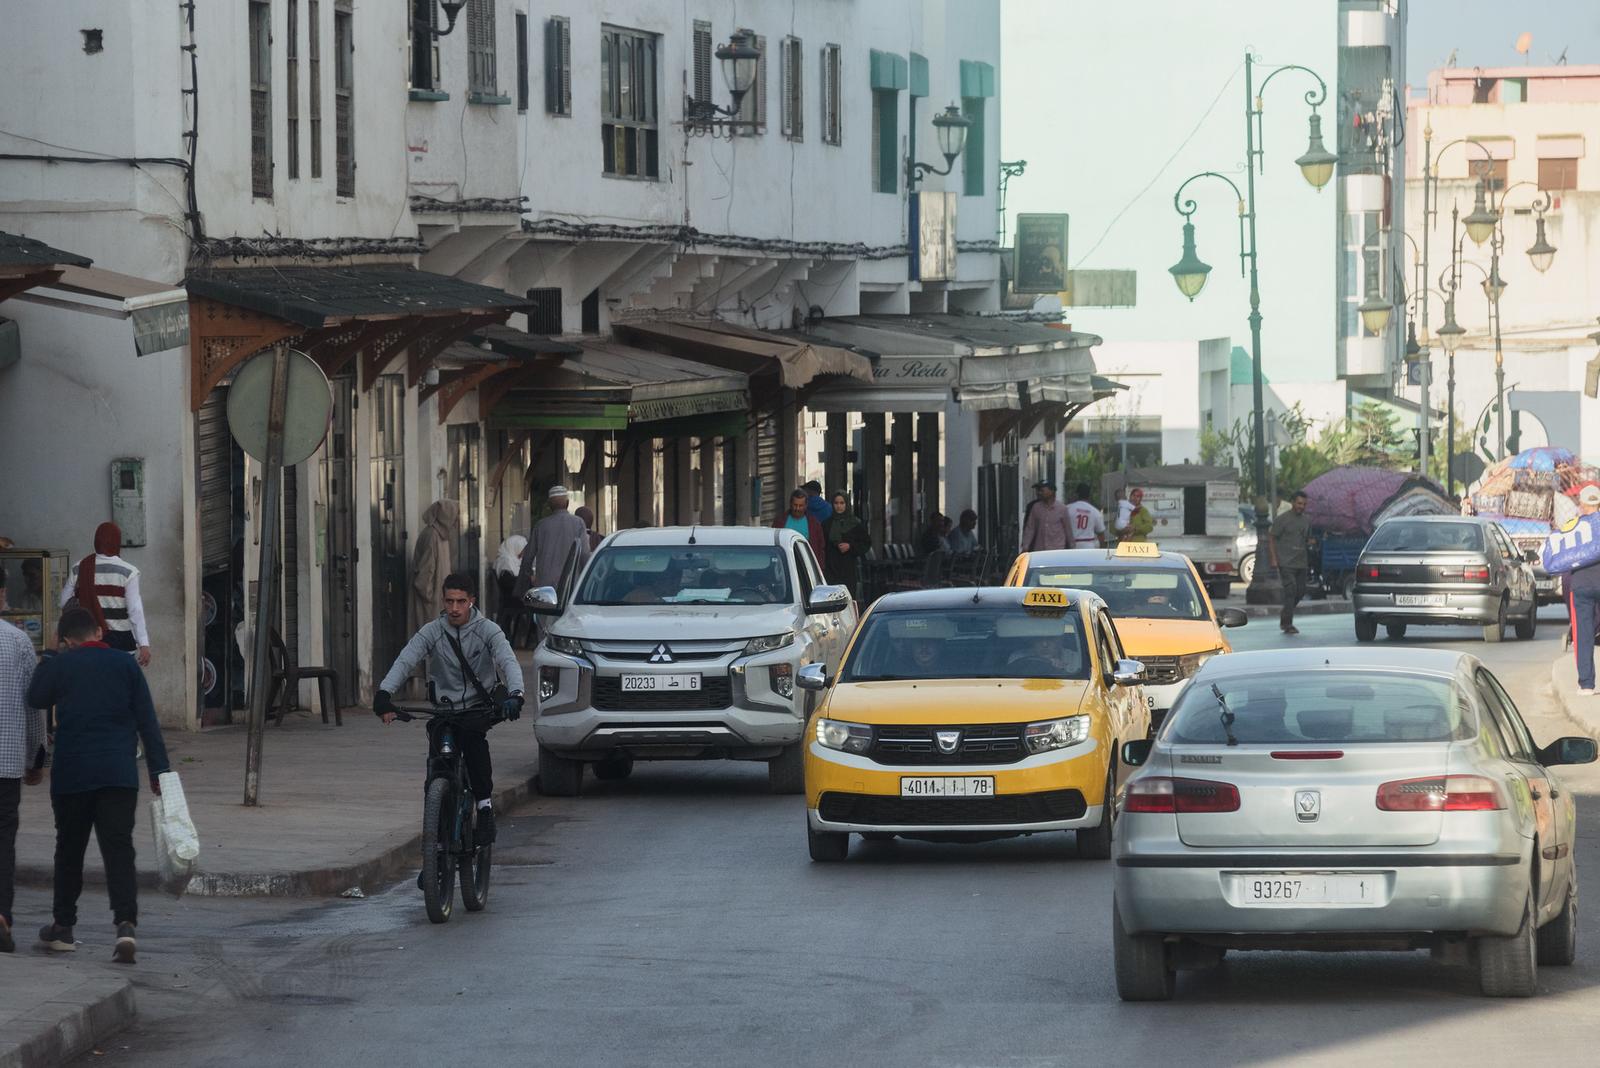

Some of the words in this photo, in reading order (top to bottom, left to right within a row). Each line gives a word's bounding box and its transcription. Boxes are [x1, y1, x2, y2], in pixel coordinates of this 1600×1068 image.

[896, 360, 948, 378] Réda
[1076, 514, 1089, 530] 10
[1126, 545, 1150, 554] TAXI
[1031, 592, 1062, 604] TAXI
[624, 677, 656, 690] 20233
[690, 676, 697, 689] 6
[1181, 754, 1223, 765] RENAULT
[973, 779, 988, 794] 78
[1254, 880, 1302, 899] 93267
[1359, 881, 1365, 899] 1
